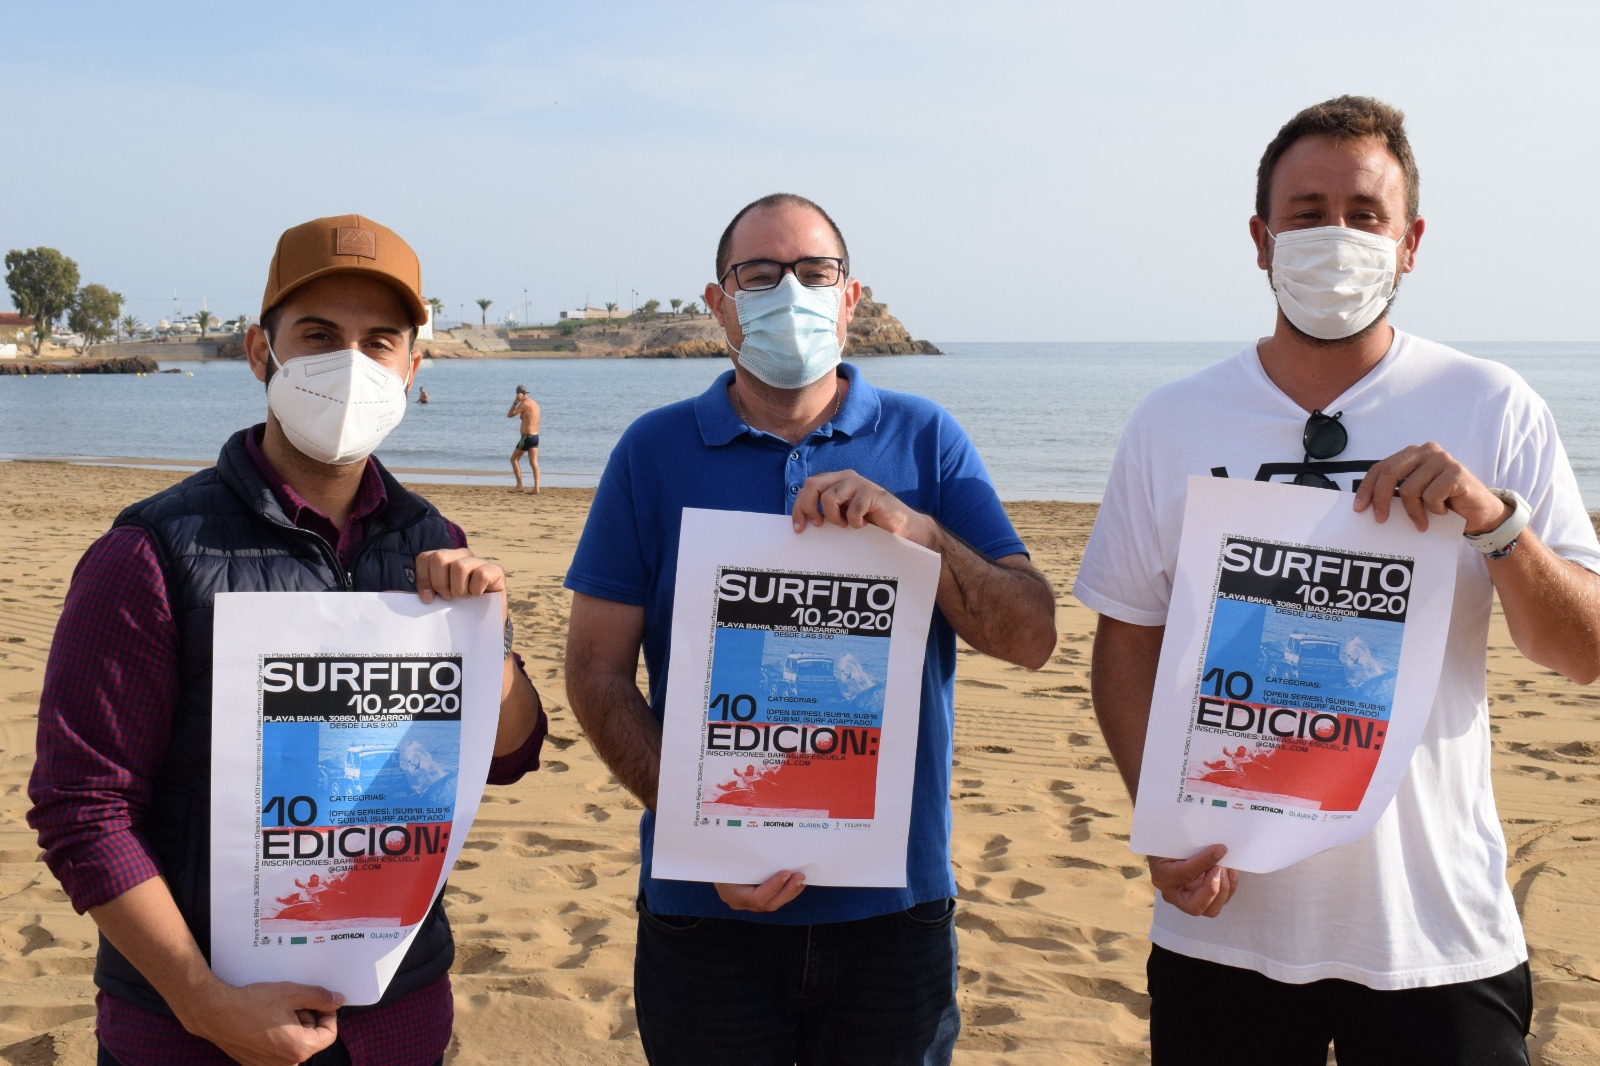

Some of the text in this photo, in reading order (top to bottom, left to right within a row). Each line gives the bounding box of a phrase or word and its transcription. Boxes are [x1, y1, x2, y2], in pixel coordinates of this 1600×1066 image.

[1222, 543, 1411, 593] SURFITO
[719, 574, 896, 610] SURFITO
[1295, 584, 1406, 615] 10.2020
[1218, 592, 1358, 617] PLAYA BAHIA, 30860, (MAZARRON)
[1276, 608, 1304, 617] DESDE
[791, 608, 891, 630] 10.2020
[264, 662, 461, 692] SURFITO
[1202, 667, 1253, 700] 10
[1266, 676, 1321, 688] CATEGORIAS:
[347, 693, 460, 714] 10.2020
[709, 694, 756, 721] 10
[1264, 690, 1288, 698] (OPEN
[1359, 702, 1386, 711] SUB16
[360, 714, 412, 722] (MAZARRON)
[1329, 705, 1379, 718] ADAPTADO)
[1197, 697, 1384, 750] EDICION:
[707, 724, 877, 755] EDICION:
[1195, 725, 1348, 752] INSCRIPCIONES: BAHIASURFESCUELA
[1256, 742, 1308, 752] @GMAIL.COM
[768, 752, 846, 760] BAHIASURFESCUELA
[329, 794, 386, 802] CATEGORIAS:
[262, 796, 317, 826] 10
[1250, 804, 1283, 815] DECATHLON
[263, 826, 448, 859] EDICION:
[328, 864, 381, 873] @GMAIL.COM
[334, 856, 419, 865] BAHIASURFESCUELA
[254, 919, 259, 927] de
